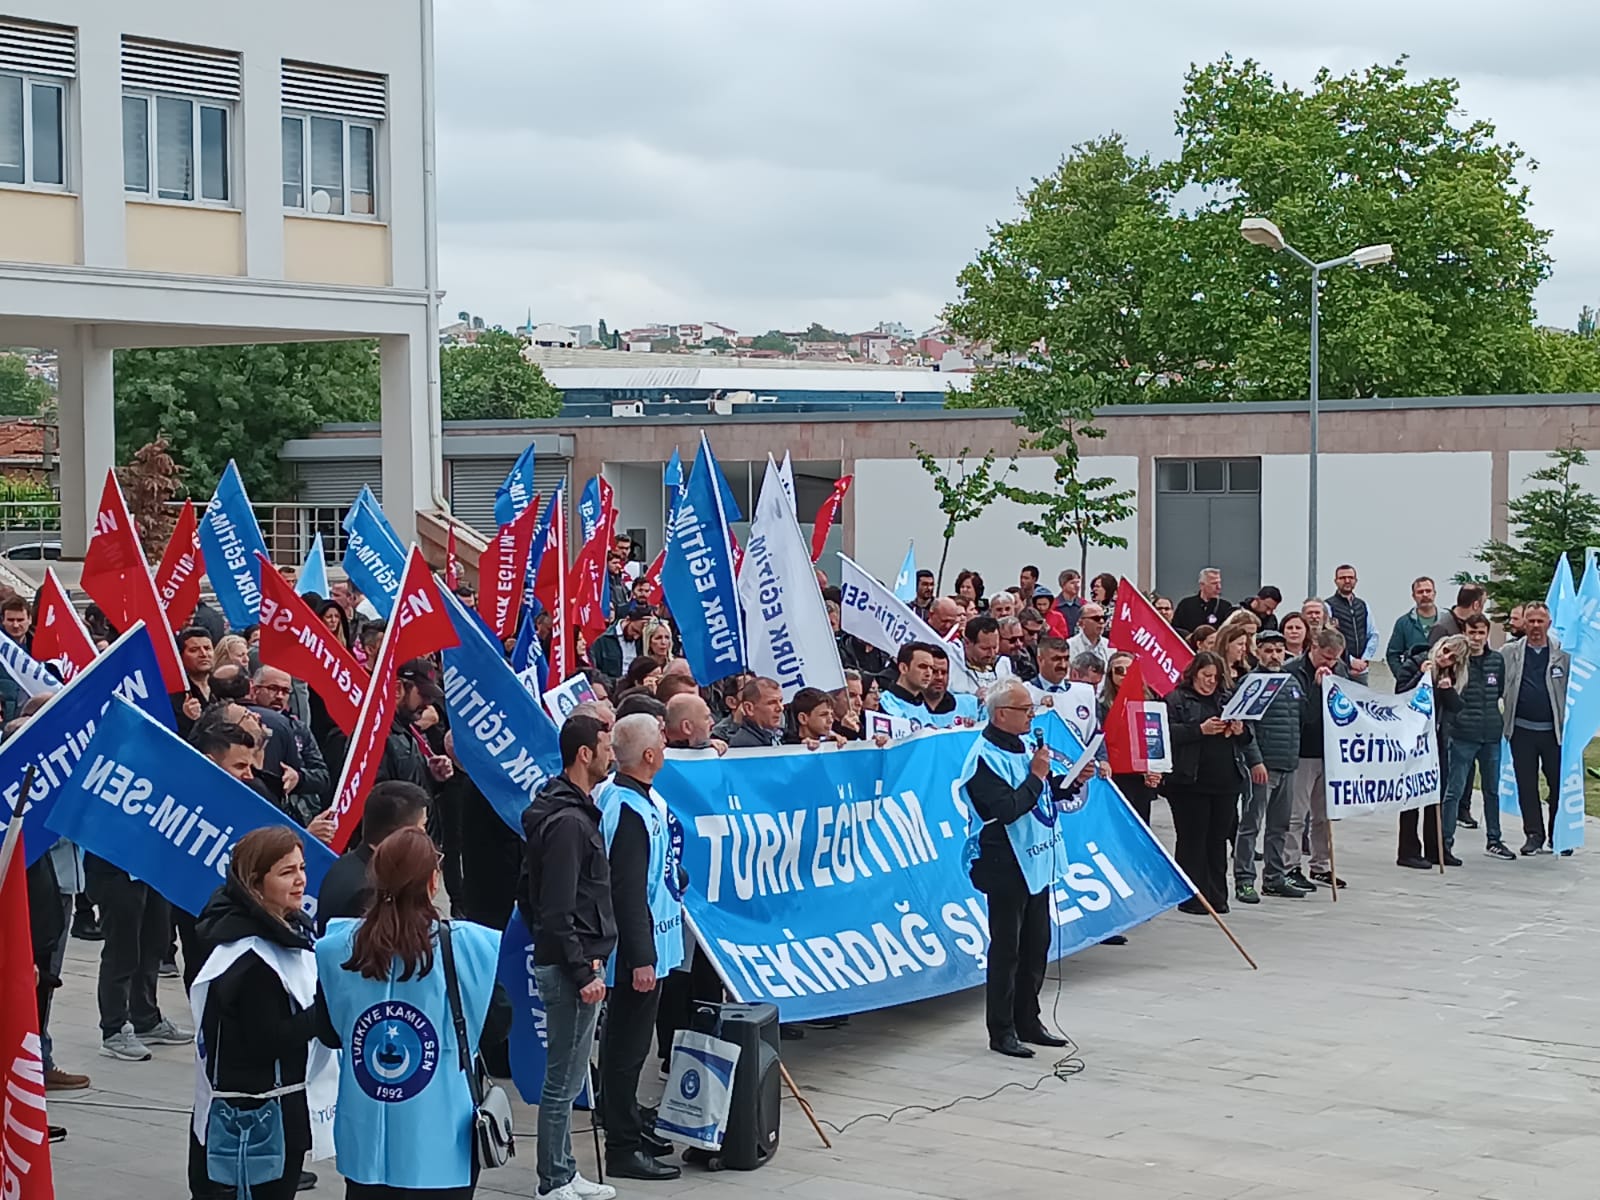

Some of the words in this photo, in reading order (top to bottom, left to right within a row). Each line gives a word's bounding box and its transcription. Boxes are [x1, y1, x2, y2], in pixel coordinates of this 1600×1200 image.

[1339, 732, 1406, 763] EĞİTİM
[695, 795, 806, 903] TÜRK
[811, 780, 939, 888] EĞİTİM
[718, 900, 947, 998] TEKİRDAĞ
[385, 1005, 426, 1030] KAMU
[421, 1040, 435, 1071] SEN
[376, 1086, 403, 1098] 1992
